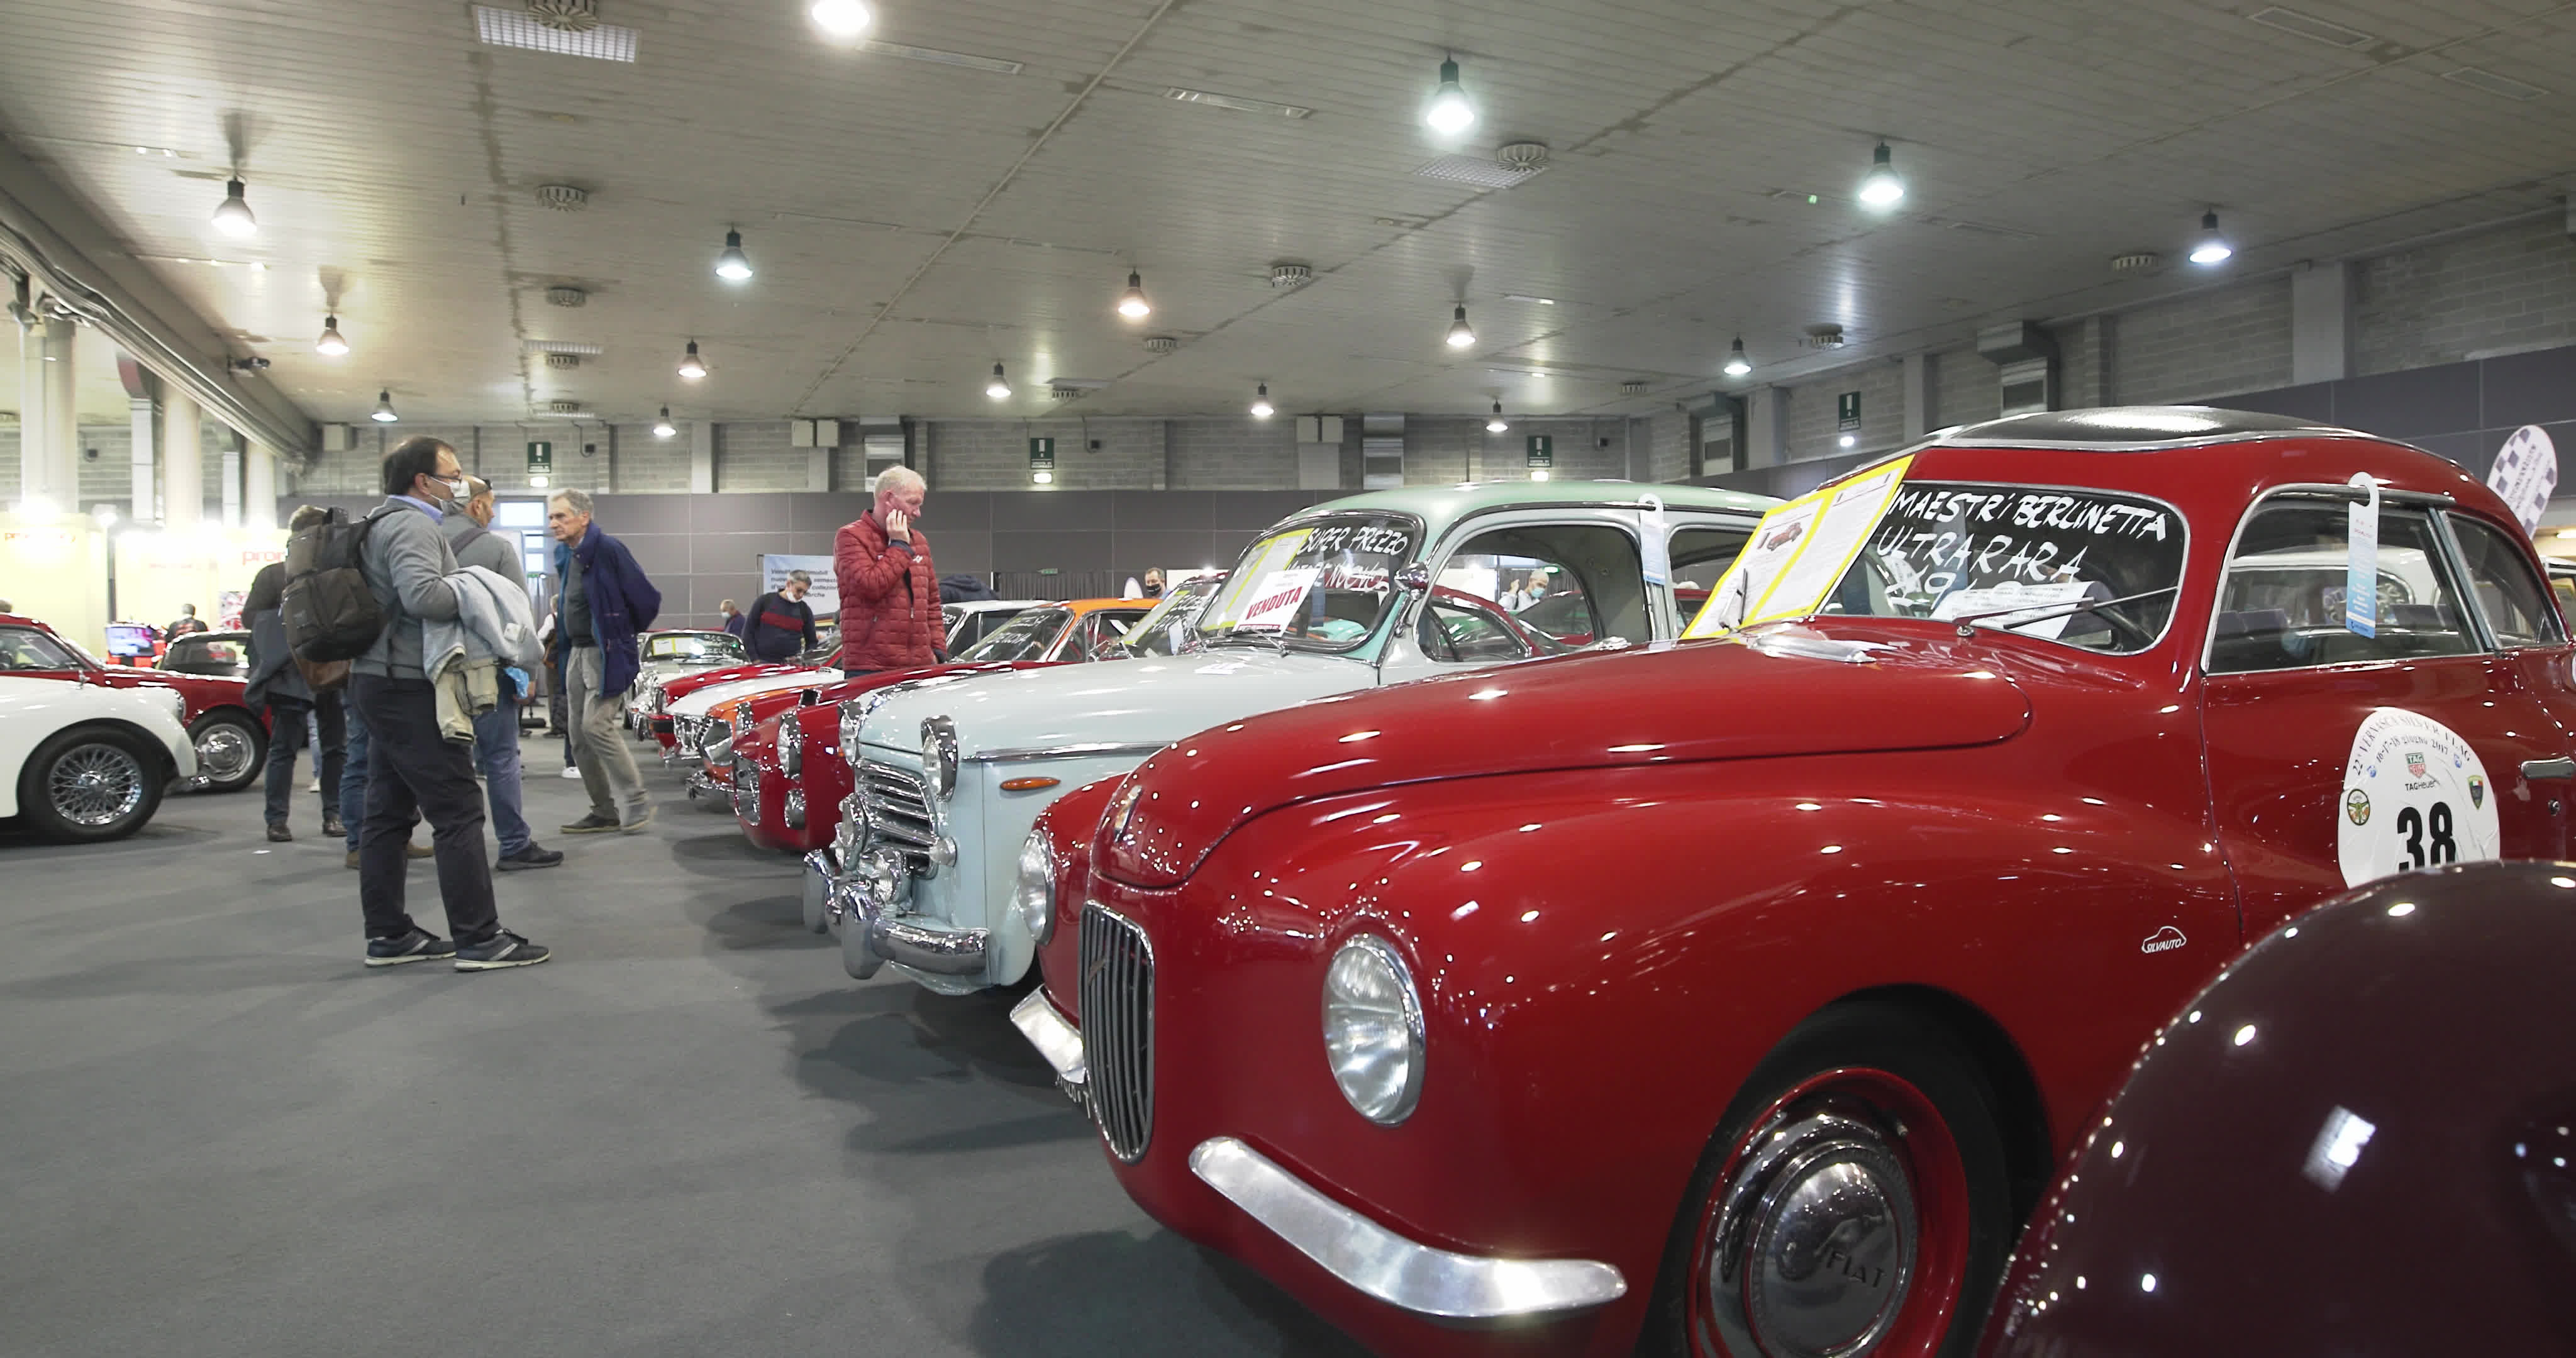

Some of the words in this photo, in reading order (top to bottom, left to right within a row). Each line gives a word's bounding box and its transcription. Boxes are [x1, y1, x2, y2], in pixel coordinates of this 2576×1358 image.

[1297, 527, 1352, 555] SUPER
[1348, 526, 1408, 556] PREZZO
[1246, 586, 1302, 619] VENDUTA
[2408, 754, 2424, 763] TAG
[2397, 802, 2457, 872] 38
[2147, 939, 2181, 953] SILVAUTO
[1827, 1250, 1885, 1288] FIAT
